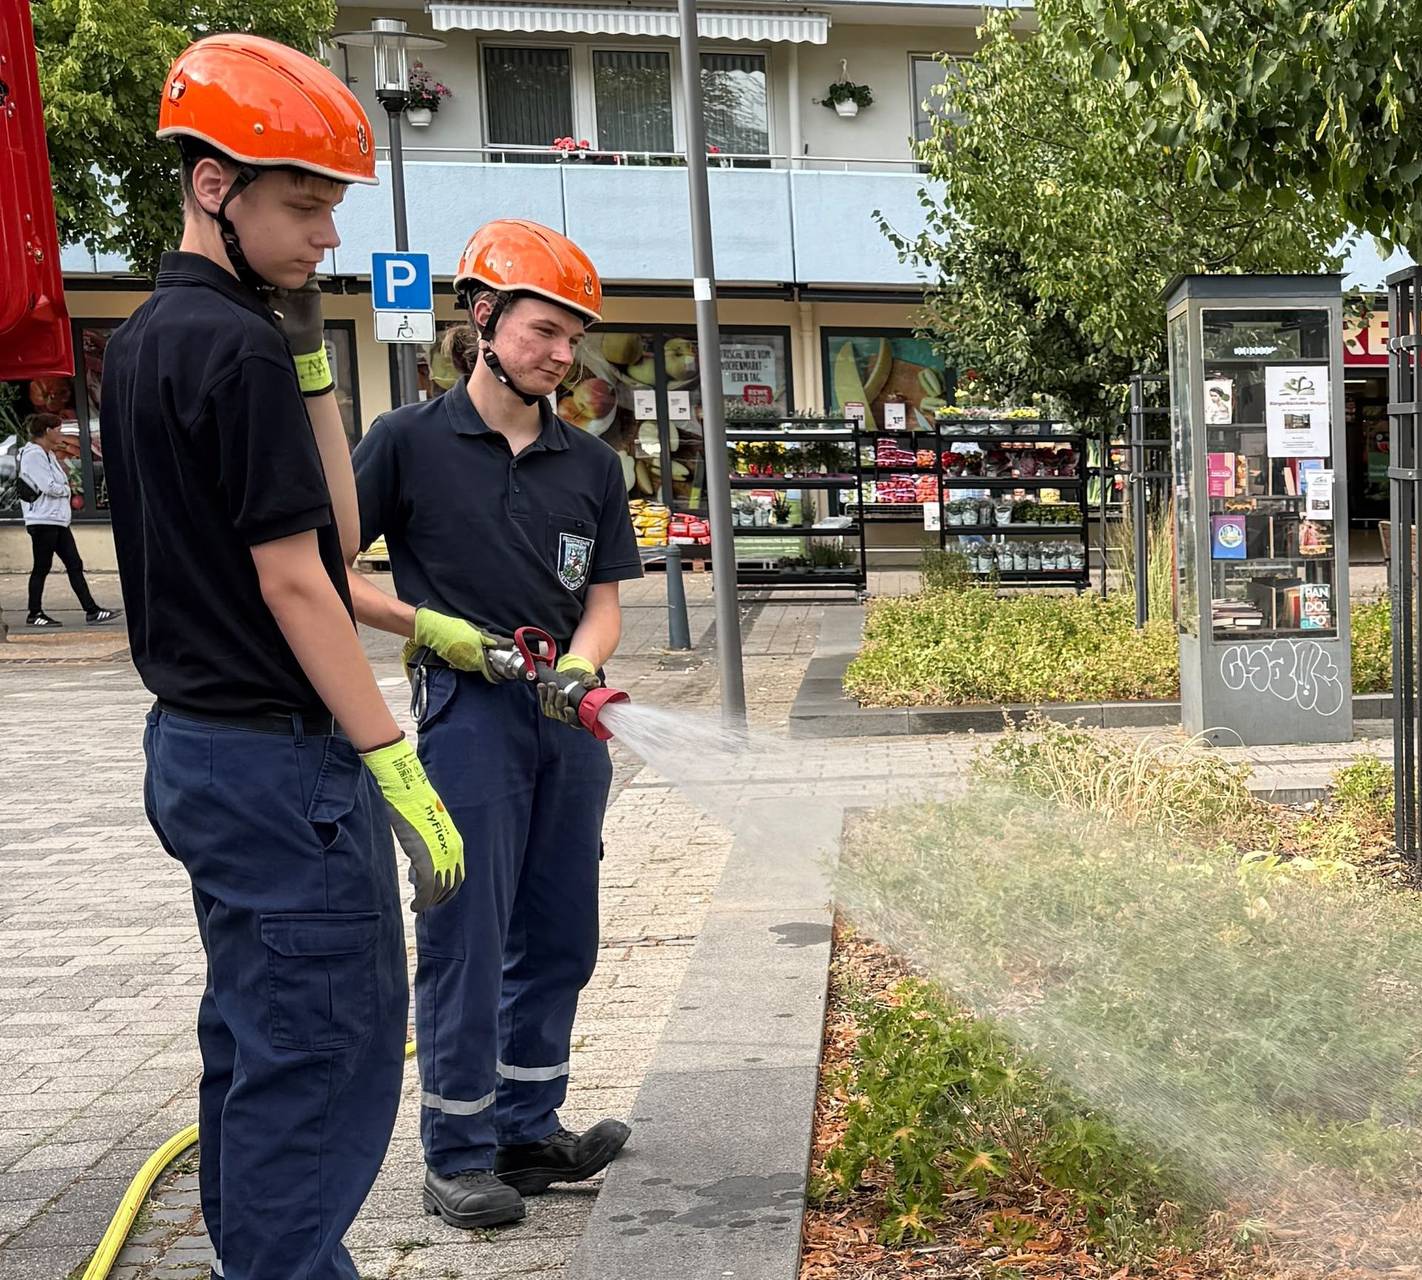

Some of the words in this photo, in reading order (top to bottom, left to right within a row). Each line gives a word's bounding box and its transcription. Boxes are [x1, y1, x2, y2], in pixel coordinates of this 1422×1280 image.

[386, 260, 417, 303] P
[1305, 588, 1329, 598] PAN
[1305, 601, 1330, 611] DOL
